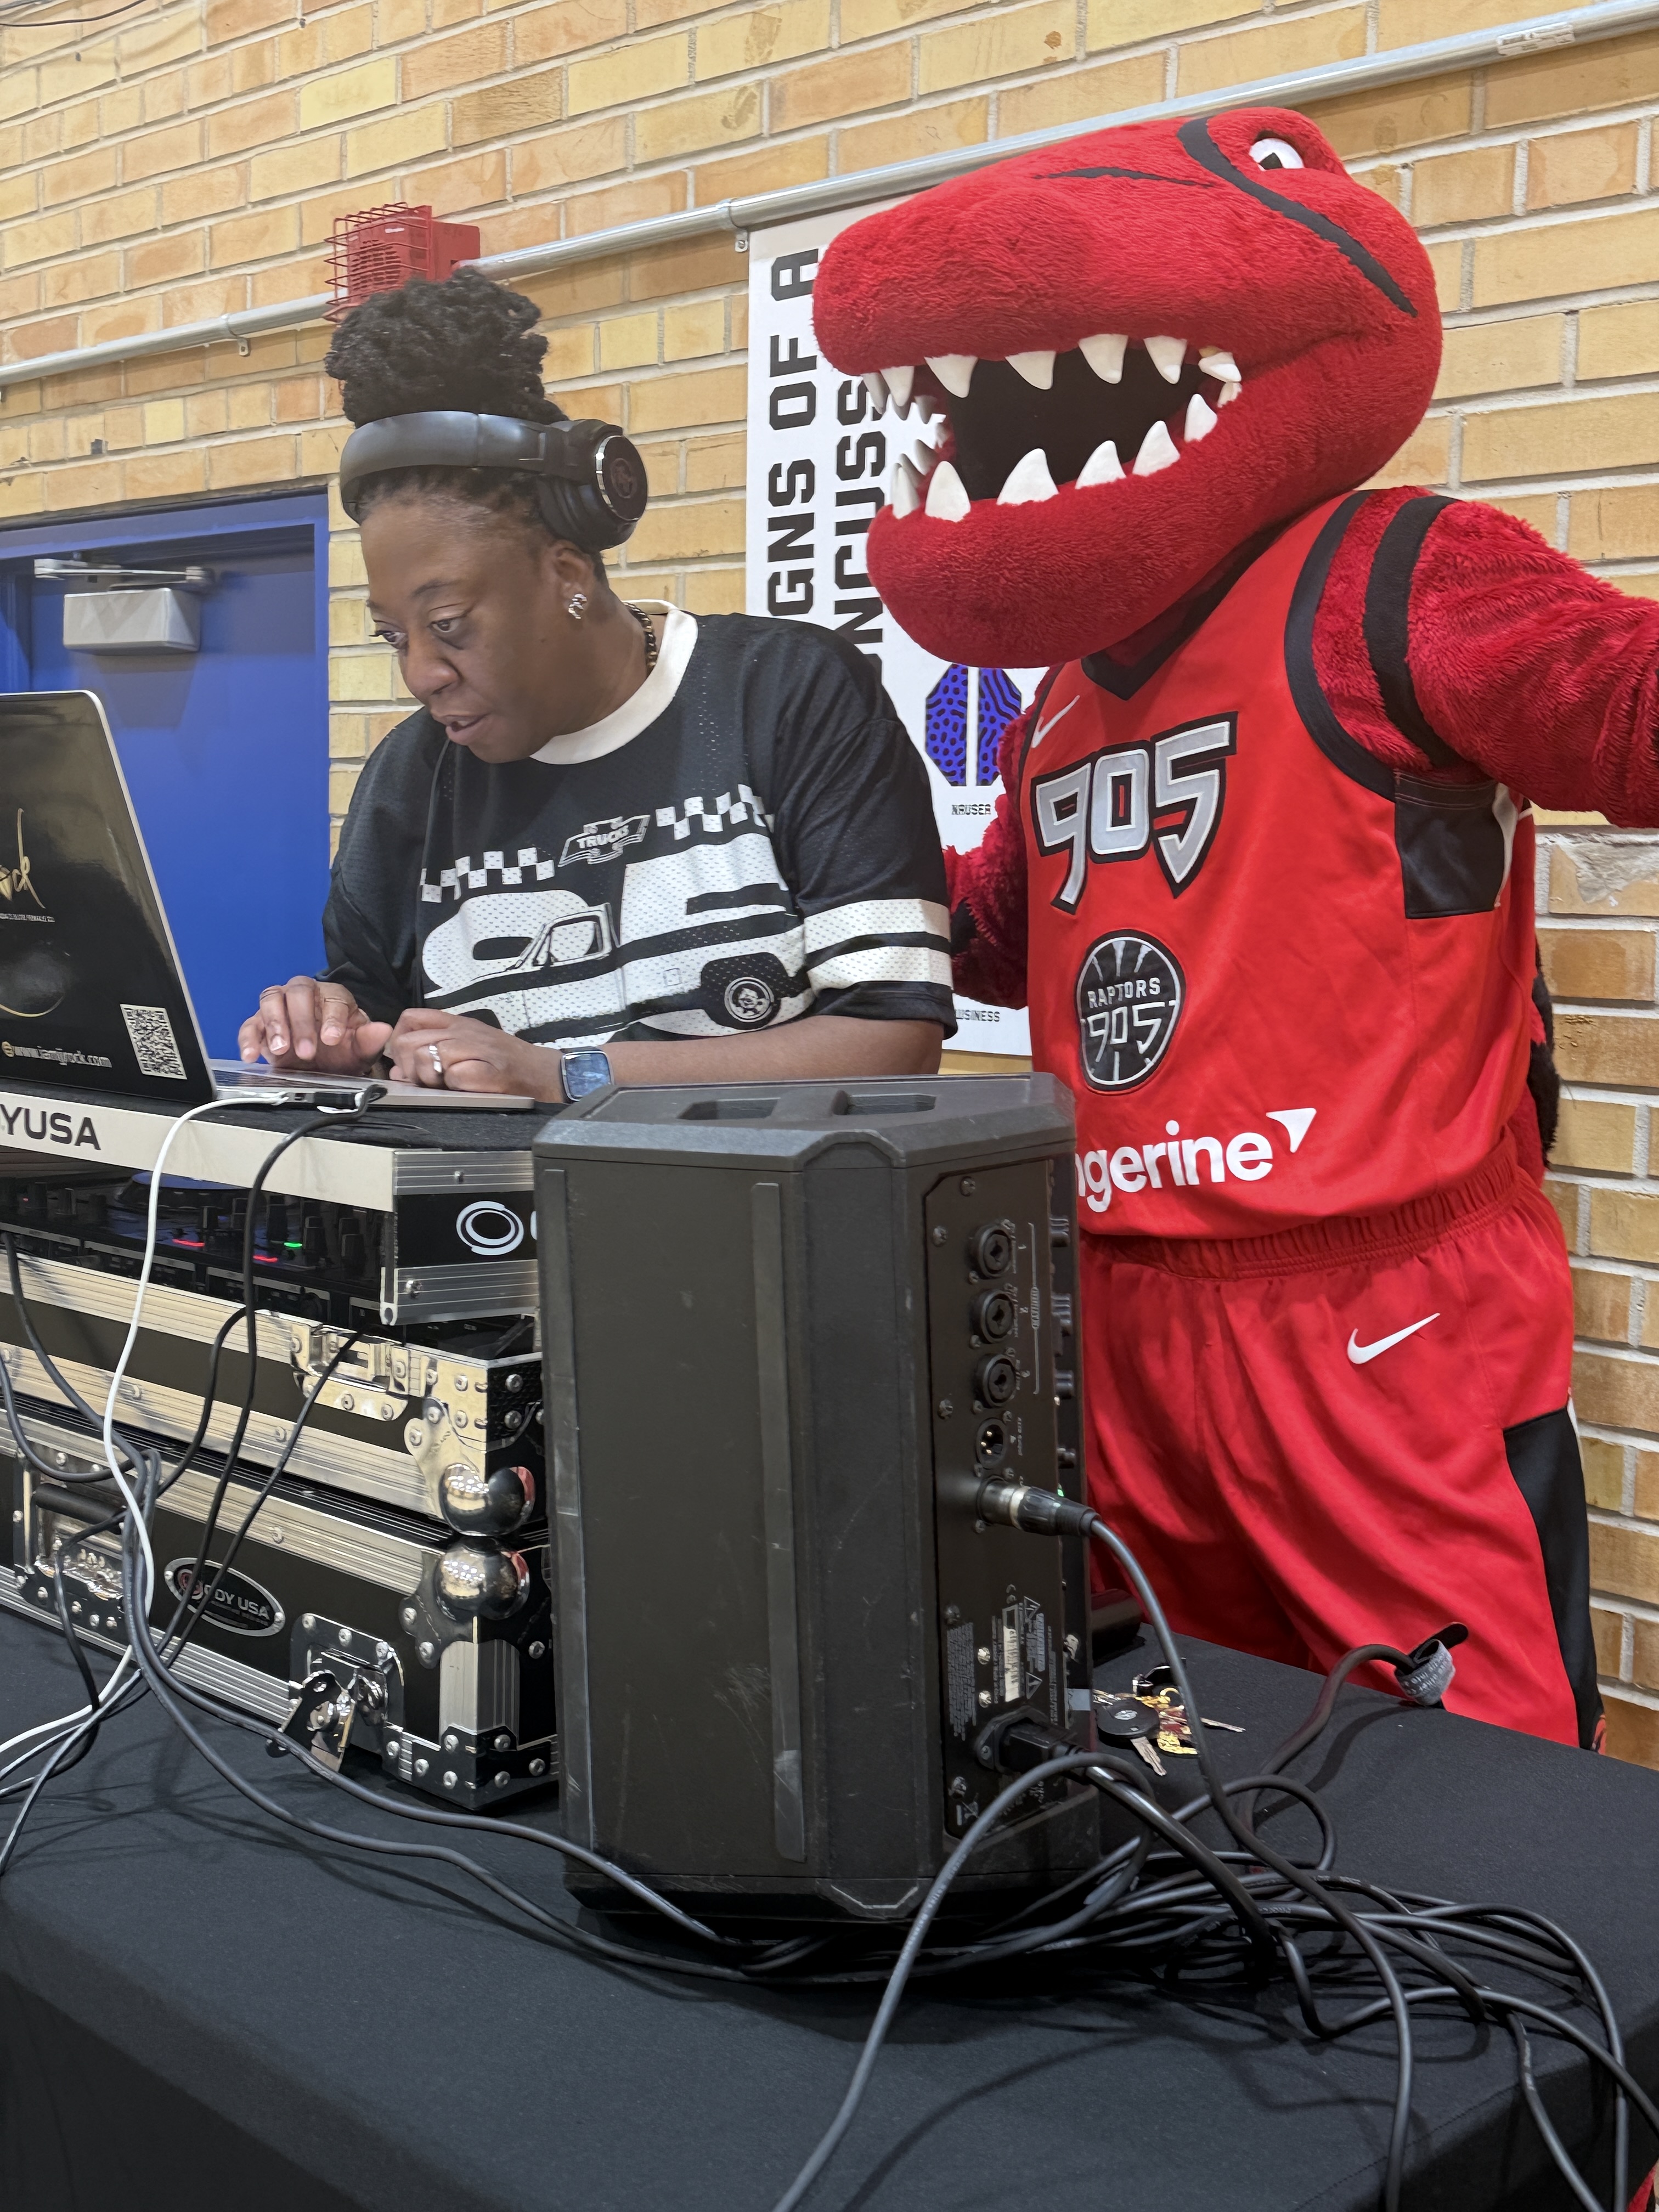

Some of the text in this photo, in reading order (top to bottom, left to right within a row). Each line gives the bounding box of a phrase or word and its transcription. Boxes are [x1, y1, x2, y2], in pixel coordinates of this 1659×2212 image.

[767, 248, 819, 617] GNS OF A
[833, 377, 886, 664] NCUSS
[1030, 711, 1238, 916] 905
[1087, 977, 1160, 1008] RAPTORS
[1086, 1001, 1166, 1063] 905
[0, 1103, 102, 1150] YUSA
[238, 1596, 270, 1621] USA
